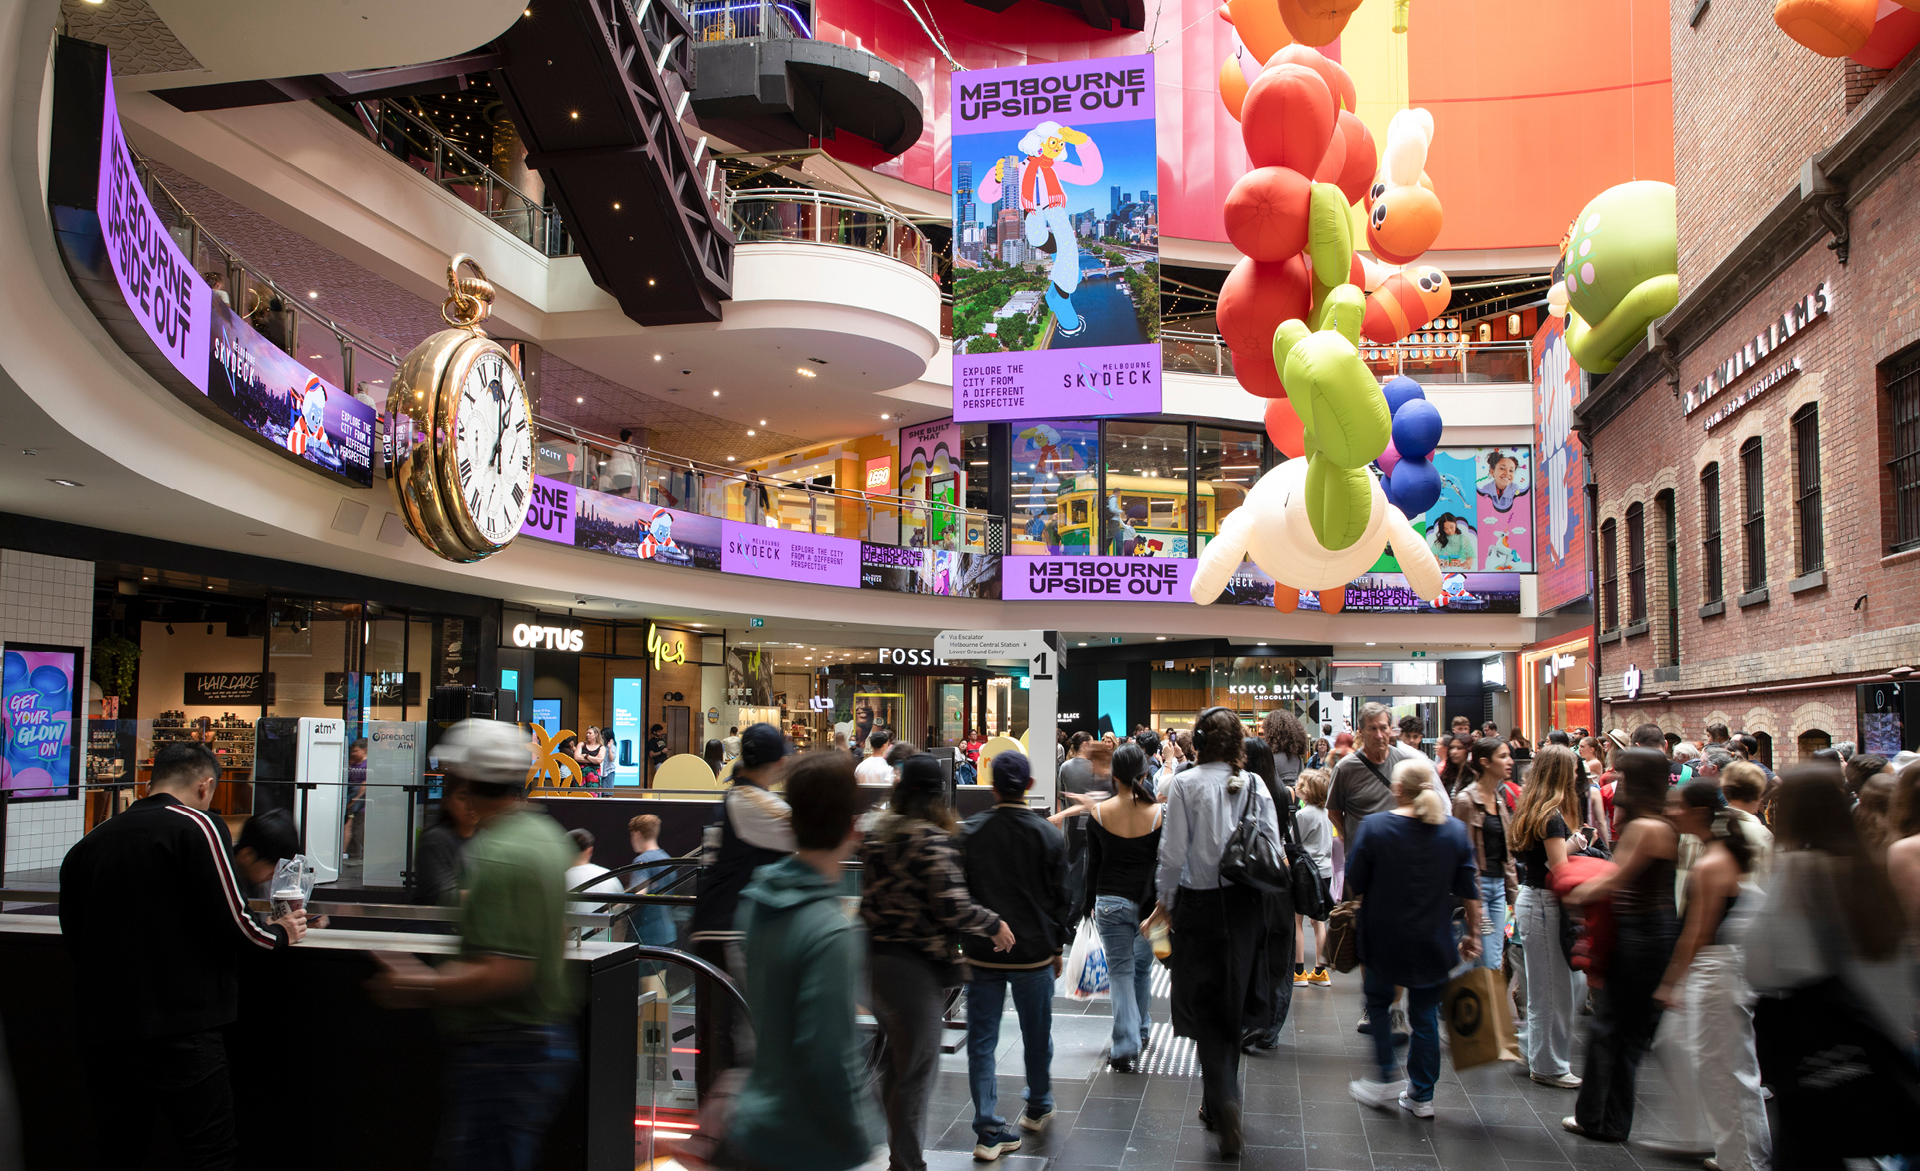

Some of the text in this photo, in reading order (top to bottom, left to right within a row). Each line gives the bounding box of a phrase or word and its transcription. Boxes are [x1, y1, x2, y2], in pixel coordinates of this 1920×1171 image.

[961, 69, 1145, 101] MELBOURNE
[961, 88, 1145, 121] UPSIDE OUT
[111, 116, 192, 317] MELBOURNE
[108, 172, 190, 360] UPSIDE OUT
[214, 337, 255, 388] SKYDECK
[963, 364, 1024, 377] EXPLORE THE
[1102, 361, 1151, 371] MELBOURNE
[963, 376, 1014, 387] CITY FROM
[1063, 370, 1152, 388] SKYDECK
[1746, 358, 1796, 402] AUSTRALIA
[963, 387, 1025, 398] A DIFFERENT
[963, 398, 1025, 409] PERSPECTIVE
[341, 410, 371, 435] EXPLORE THE
[908, 423, 950, 438] SHE BUILT
[340, 422, 352, 437] CITY
[354, 428, 366, 442] FROM
[918, 432, 940, 442] THAT
[345, 436, 370, 456] DIFFERENT
[340, 445, 370, 469] PERSPECTIVE
[867, 467, 890, 487] LEGO
[525, 505, 567, 533] OUT
[729, 541, 780, 560] SKYDECK
[752, 538, 780, 547] MELBOURNE
[791, 544, 844, 557] EXPLORE THE CITY
[791, 552, 804, 561] FROM
[814, 555, 843, 565] DIFFERENT
[791, 560, 827, 571] PERSPECTIVE
[863, 552, 921, 567] UPSIDE OUT
[1029, 562, 1178, 578] MELBOURNE
[1029, 578, 1178, 595] UPSIDE OUT
[1229, 577, 1254, 588] DECK
[1346, 597, 1417, 606] UPSIDE OUT
[513, 623, 583, 651] OPTUS
[1229, 684, 1319, 694] KOKO BLACK
[10, 693, 40, 712] GET
[14, 710, 49, 726] YOUR
[18, 724, 64, 746] GLOW
[381, 733, 415, 742] precinct
[39, 741, 59, 756] ON
[397, 742, 414, 750] ATM
